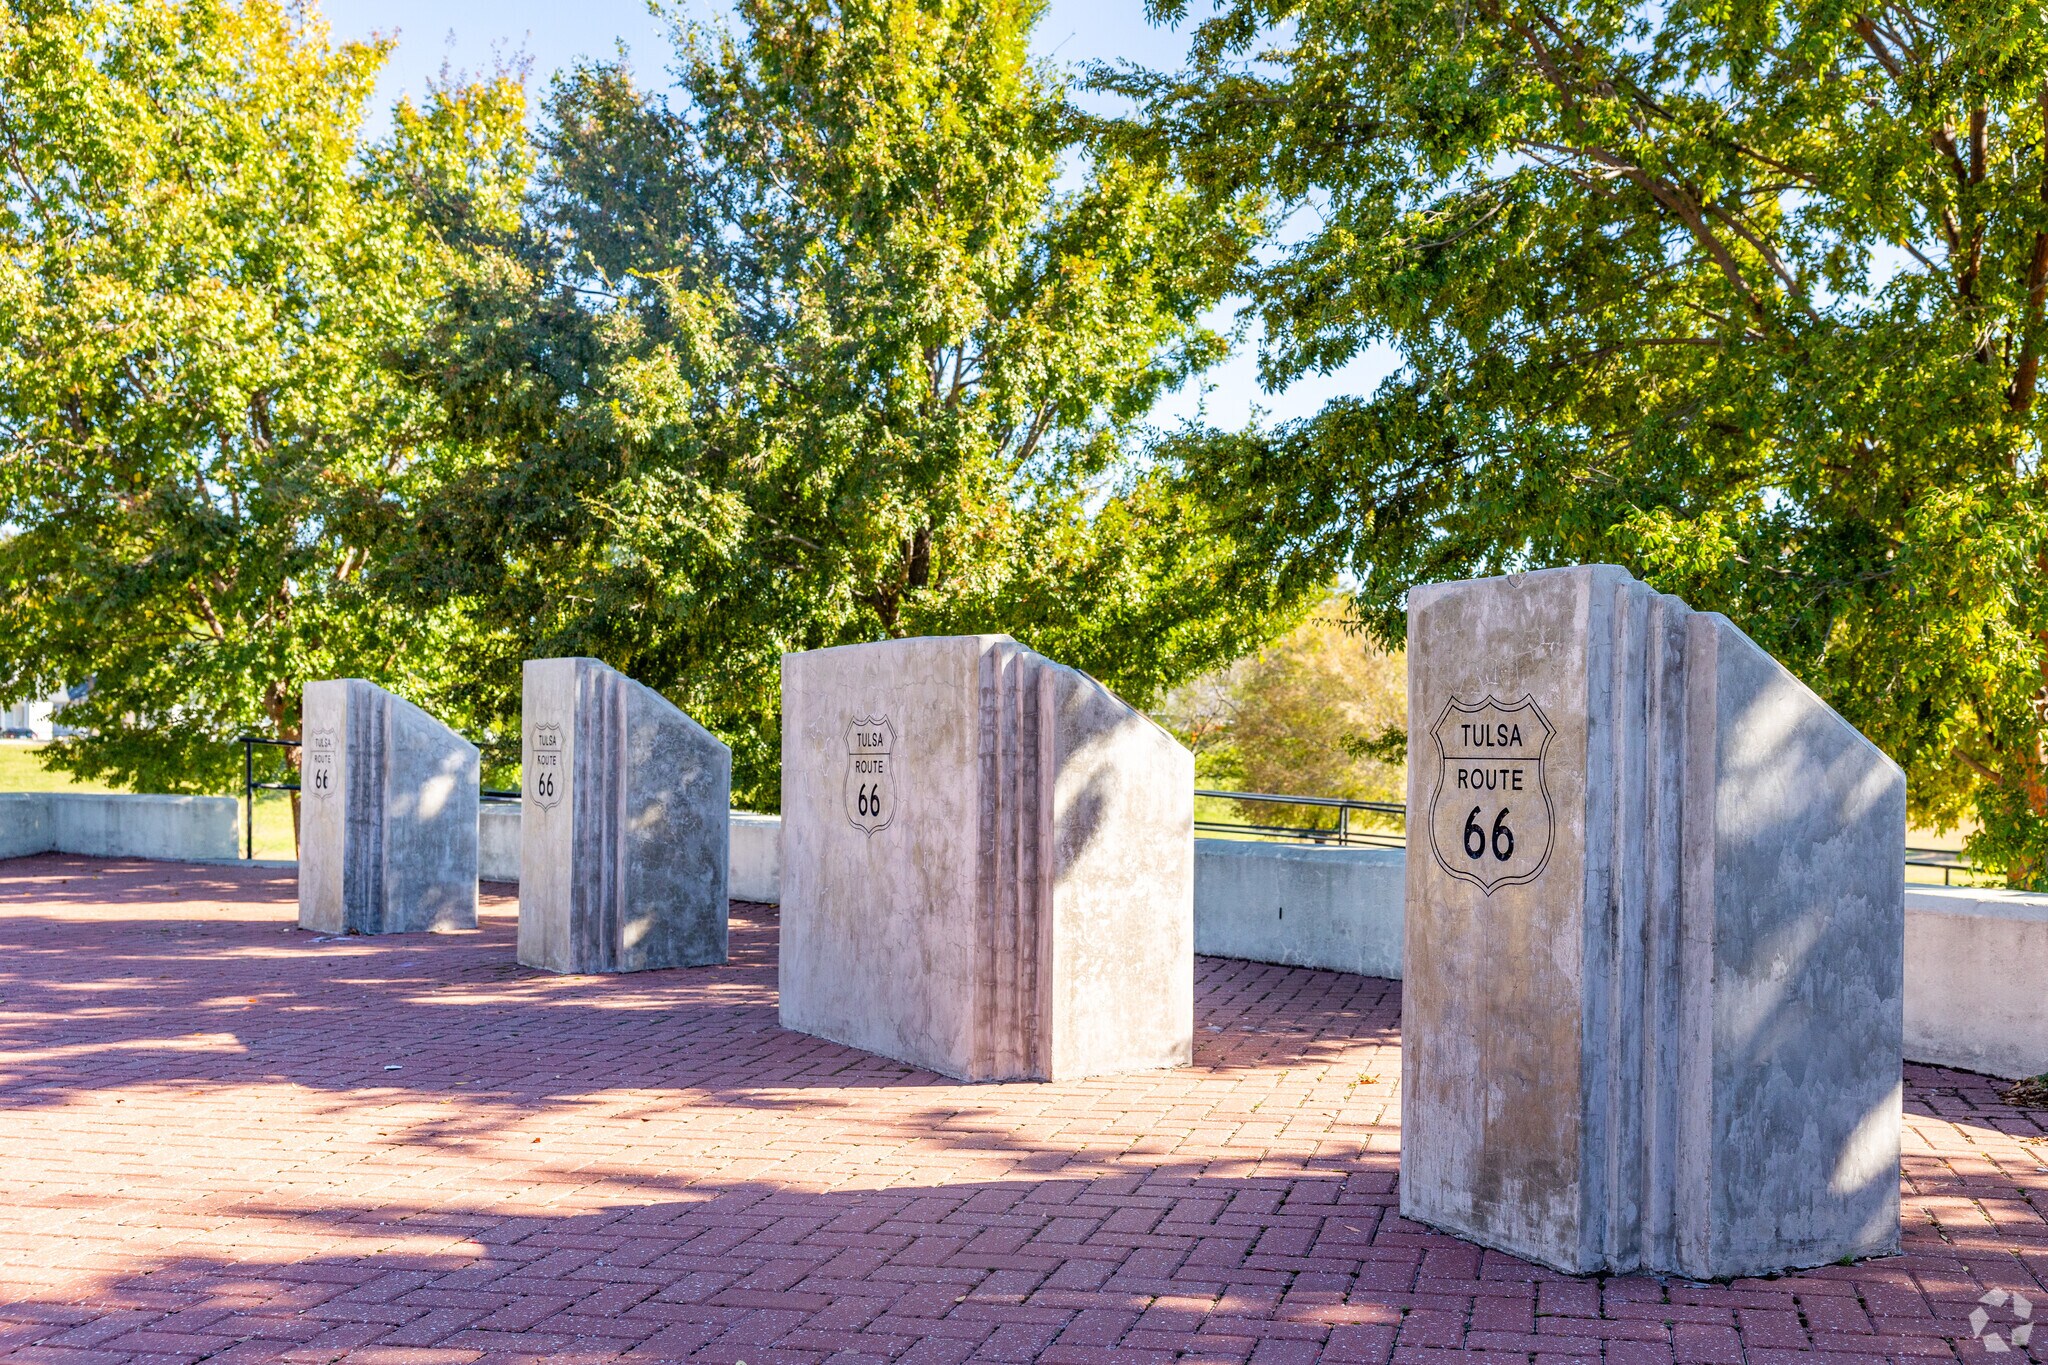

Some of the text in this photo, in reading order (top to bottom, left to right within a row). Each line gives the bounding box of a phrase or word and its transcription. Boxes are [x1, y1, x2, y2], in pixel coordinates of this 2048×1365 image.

[315, 738, 331, 747] TULSA
[539, 735, 556, 746] TULSA
[857, 732, 883, 747] TULSA
[1461, 723, 1523, 747] TULSA
[314, 754, 331, 763] ROUTE
[537, 755, 556, 765] ROUTE
[855, 760, 883, 773] ROUTE
[315, 769, 328, 789] 66
[538, 772, 554, 797] 66
[1458, 768, 1523, 790] ROUTE
[858, 783, 880, 817] 66
[1464, 805, 1514, 862] 66
